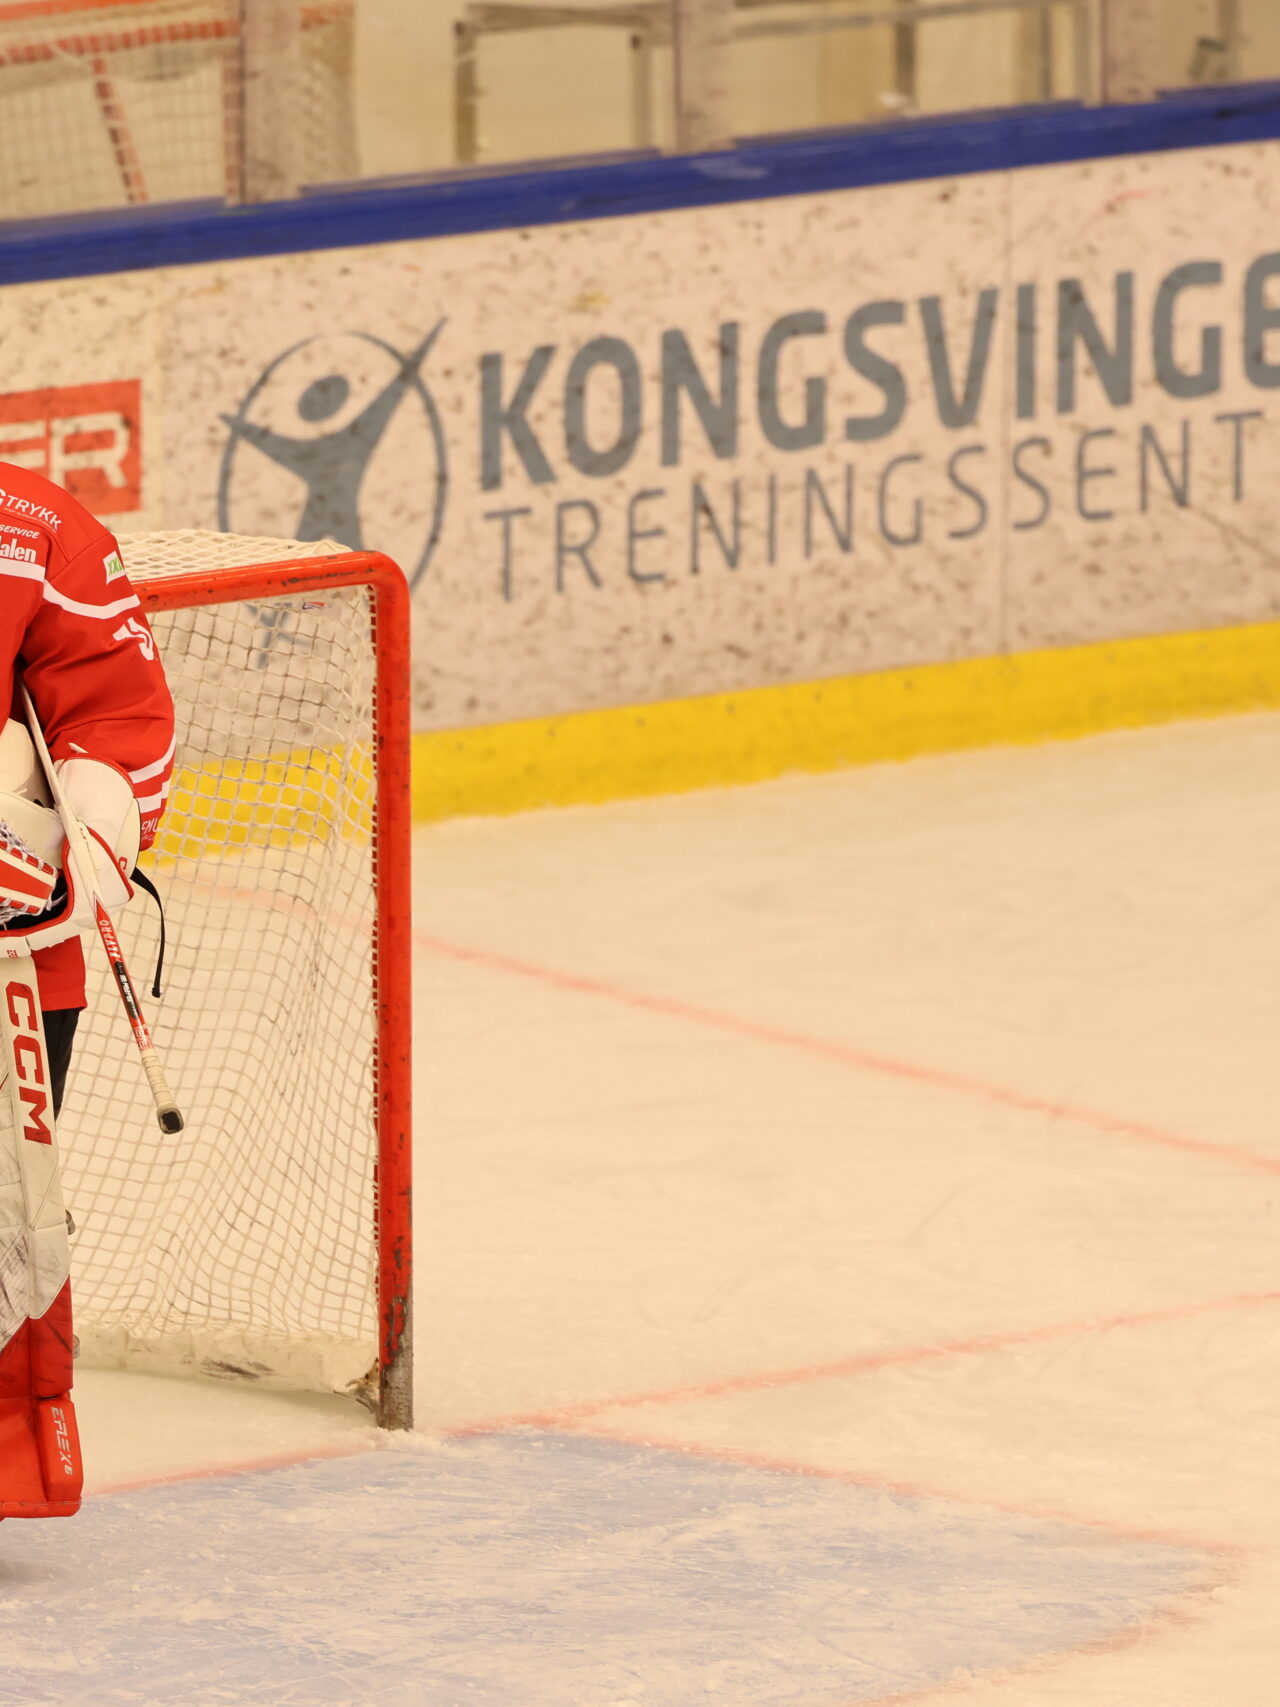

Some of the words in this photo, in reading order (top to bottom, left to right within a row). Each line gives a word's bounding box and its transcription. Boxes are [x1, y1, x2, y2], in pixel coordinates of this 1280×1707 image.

[6, 495, 62, 530] TRYKK
[483, 410, 1263, 601] TRENINGSSENT
[5, 981, 53, 1145] CCM
